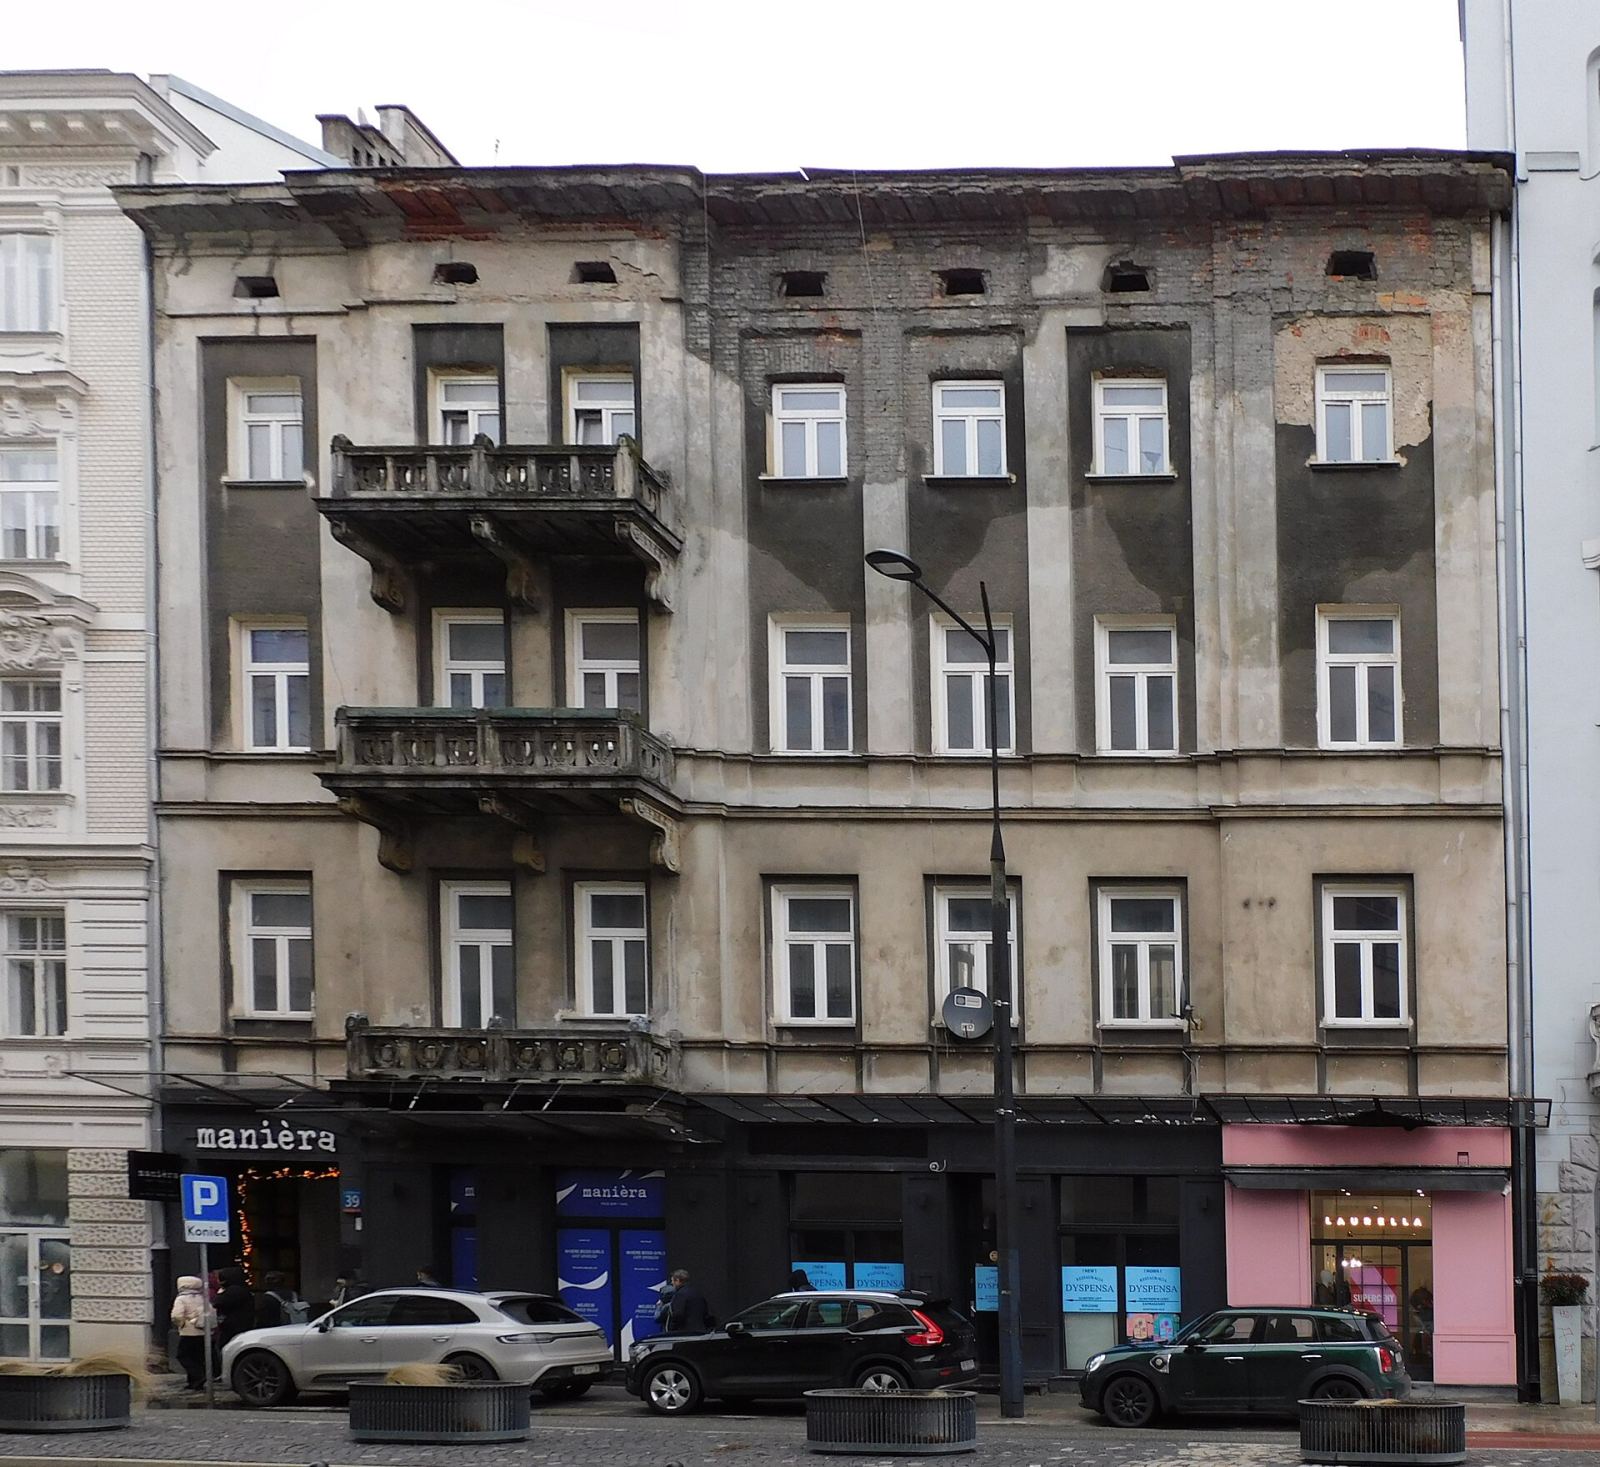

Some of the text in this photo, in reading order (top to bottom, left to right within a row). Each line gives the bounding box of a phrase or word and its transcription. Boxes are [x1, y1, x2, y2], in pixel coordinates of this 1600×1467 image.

[196, 1120, 336, 1152] manièra
[192, 1180, 219, 1215] P
[582, 1185, 647, 1198] manièra
[344, 1194, 360, 1208] 39
[1324, 1216, 1423, 1227] LAURELLA
[187, 1225, 227, 1238] Koniec
[857, 1279, 905, 1288] DYSPENSA
[1065, 1284, 1114, 1292] DYSPENSA
[1129, 1285, 1178, 1293] DYSPENSA
